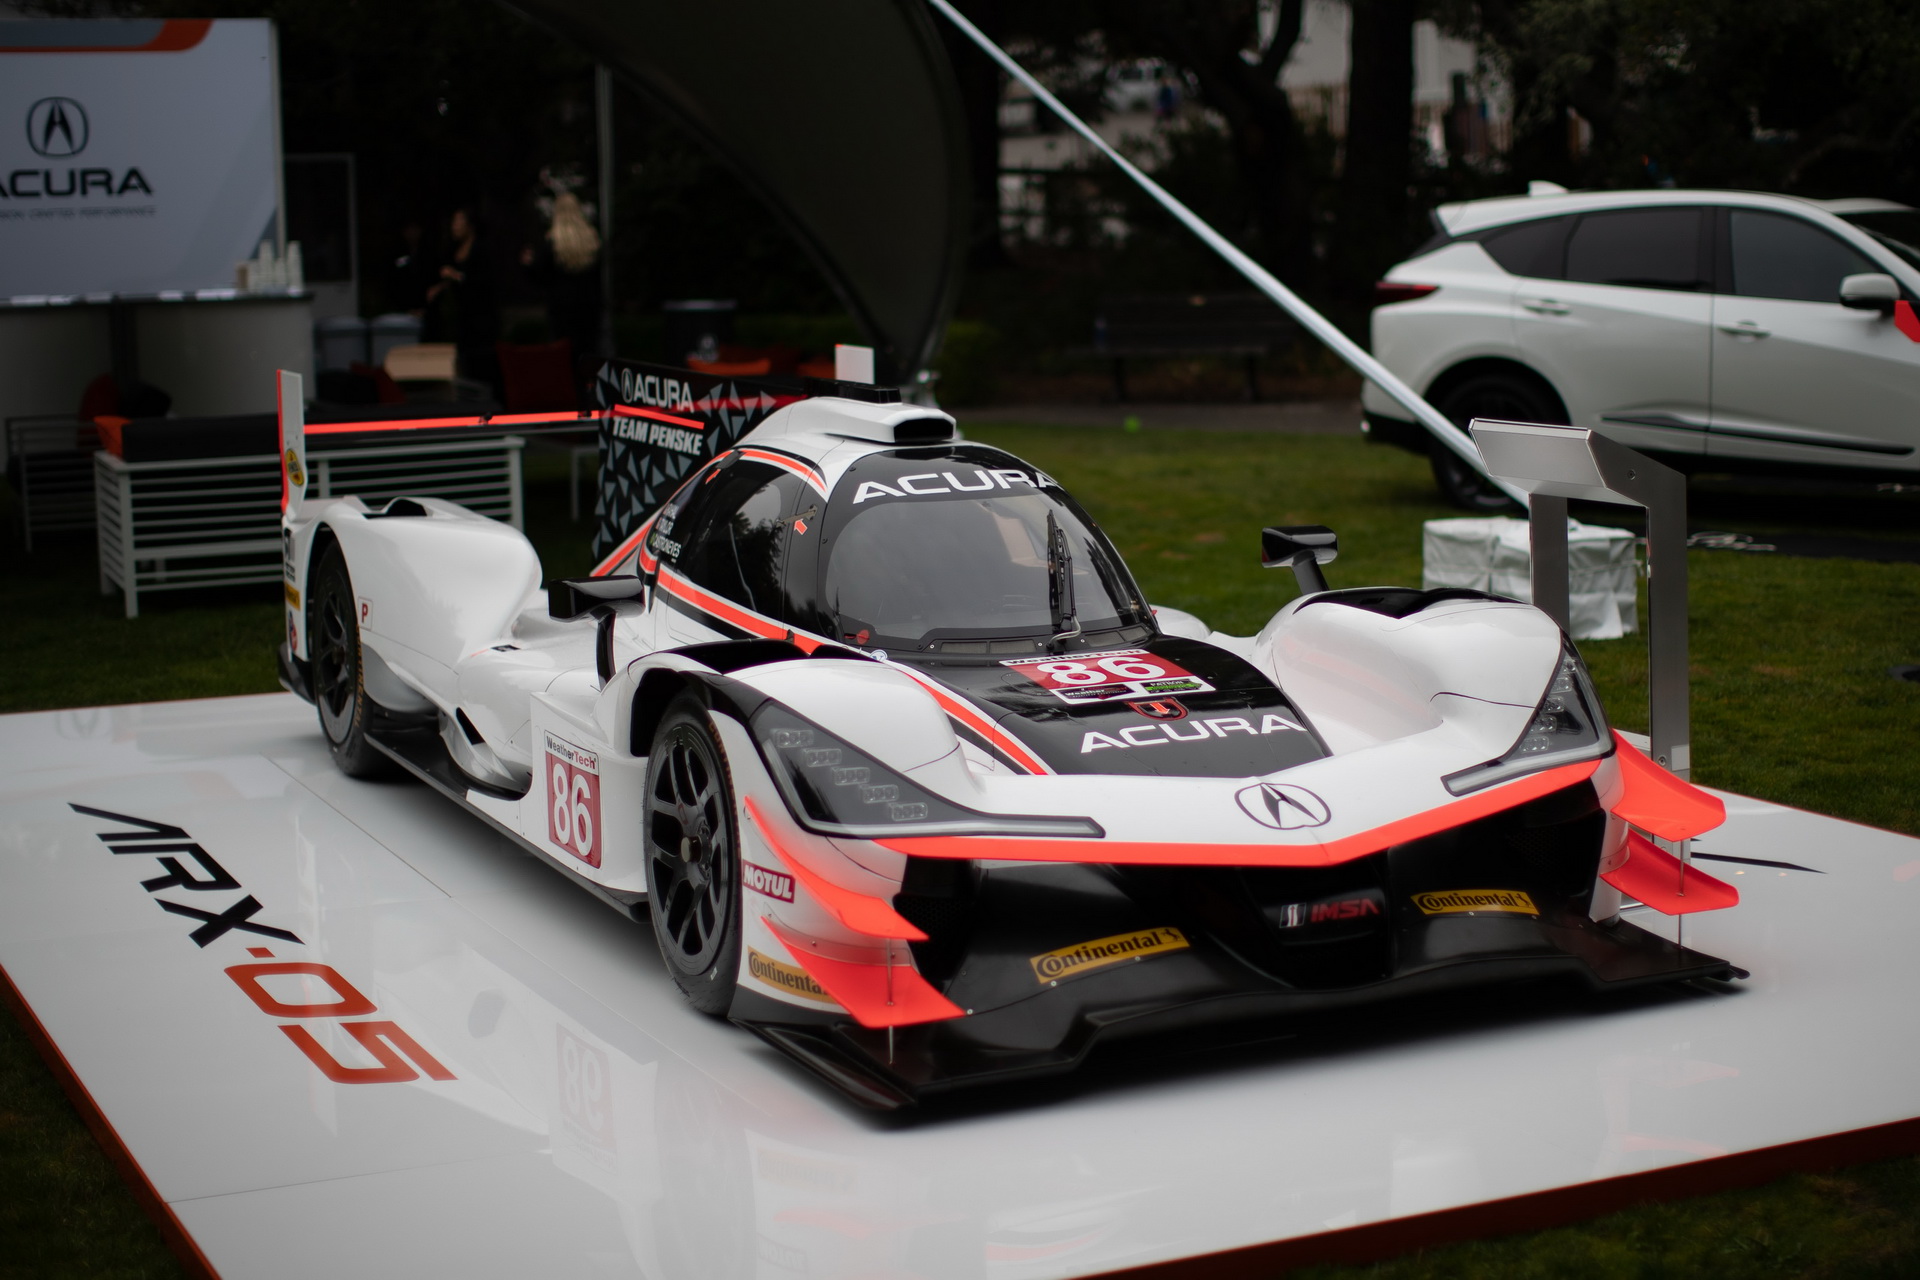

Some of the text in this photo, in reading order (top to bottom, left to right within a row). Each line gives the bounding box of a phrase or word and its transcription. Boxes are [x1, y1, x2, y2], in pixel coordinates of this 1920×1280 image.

[634, 372, 695, 414] ACURA
[612, 415, 704, 456] TEAM PENSKE
[361, 603, 369, 623] P
[1037, 656, 1166, 684] 86
[1080, 714, 1308, 753] ACURA
[546, 736, 596, 770] WeatherTech
[552, 763, 593, 857] 86
[743, 864, 793, 899] MOTUL
[1311, 898, 1379, 922] IMSA
[1416, 891, 1517, 912] Continental
[1036, 930, 1164, 978] Continental
[749, 951, 828, 996] Continenta
